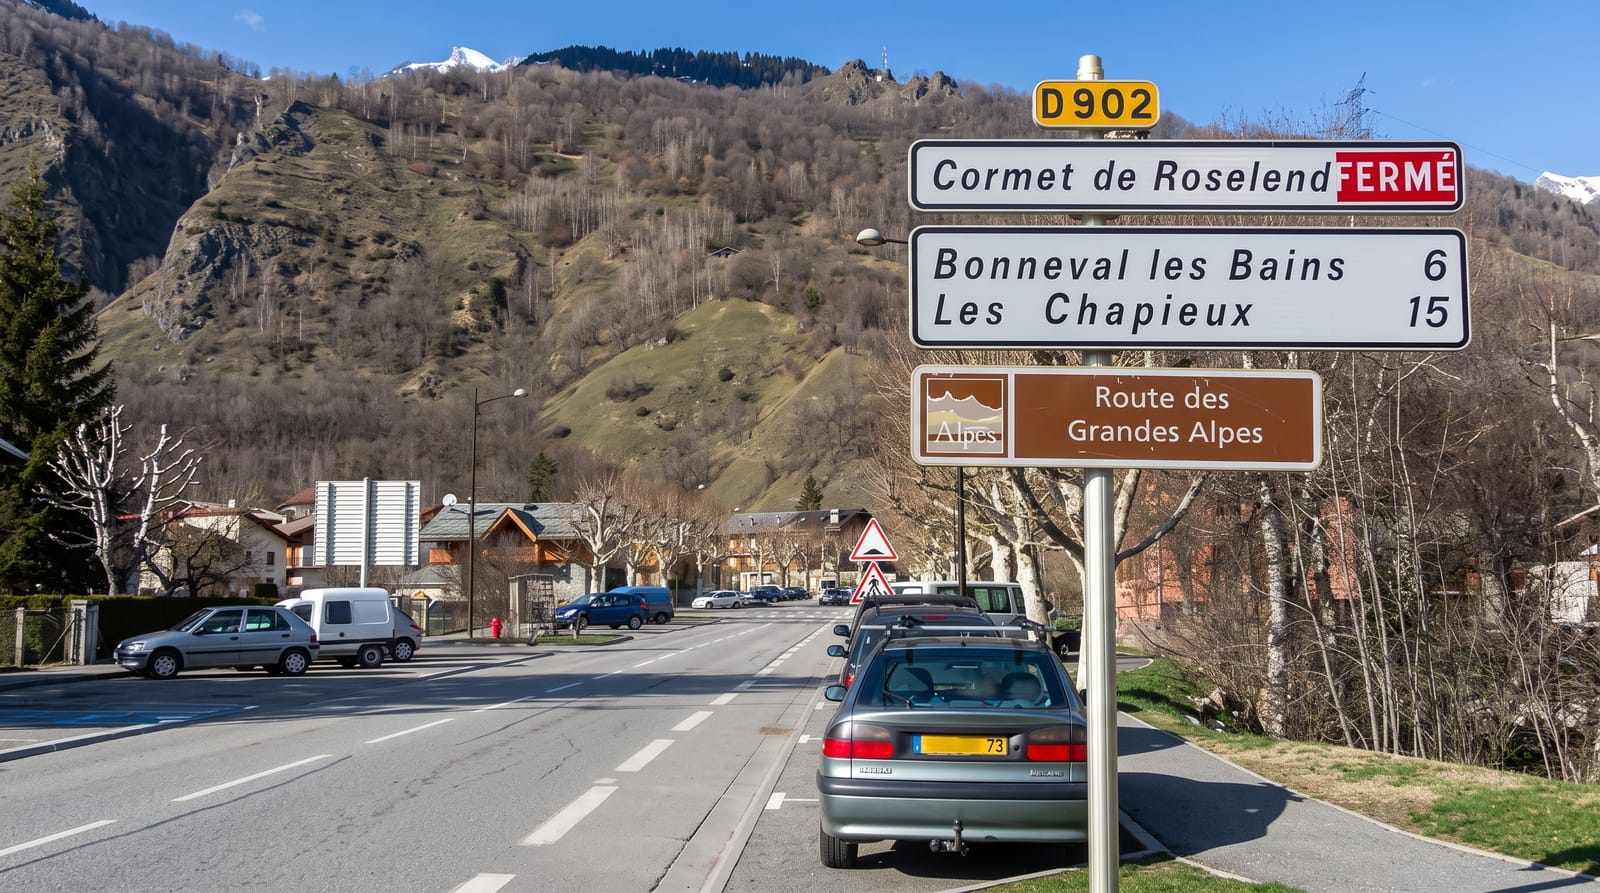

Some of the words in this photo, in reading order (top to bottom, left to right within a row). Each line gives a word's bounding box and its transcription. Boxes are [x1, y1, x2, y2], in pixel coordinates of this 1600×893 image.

[933, 158, 1074, 191] Cormet
[1093, 159, 1136, 191] de
[1153, 160, 1332, 192] Roselend
[1336, 152, 1455, 192] FERMÉ
[933, 247, 1129, 281] Bonneval
[1149, 248, 1207, 281] les
[1228, 248, 1345, 281] Bains
[1424, 249, 1447, 282] 6
[933, 293, 1004, 326] Les
[1045, 292, 1253, 335] Chapieux
[1409, 295, 1450, 328] 15
[1096, 386, 1175, 409] Route
[1184, 385, 1229, 409] des
[935, 421, 997, 450] Alpes
[1068, 419, 1180, 443] Grandes
[1188, 420, 1263, 449] Alpes
[986, 738, 1004, 753] 73
